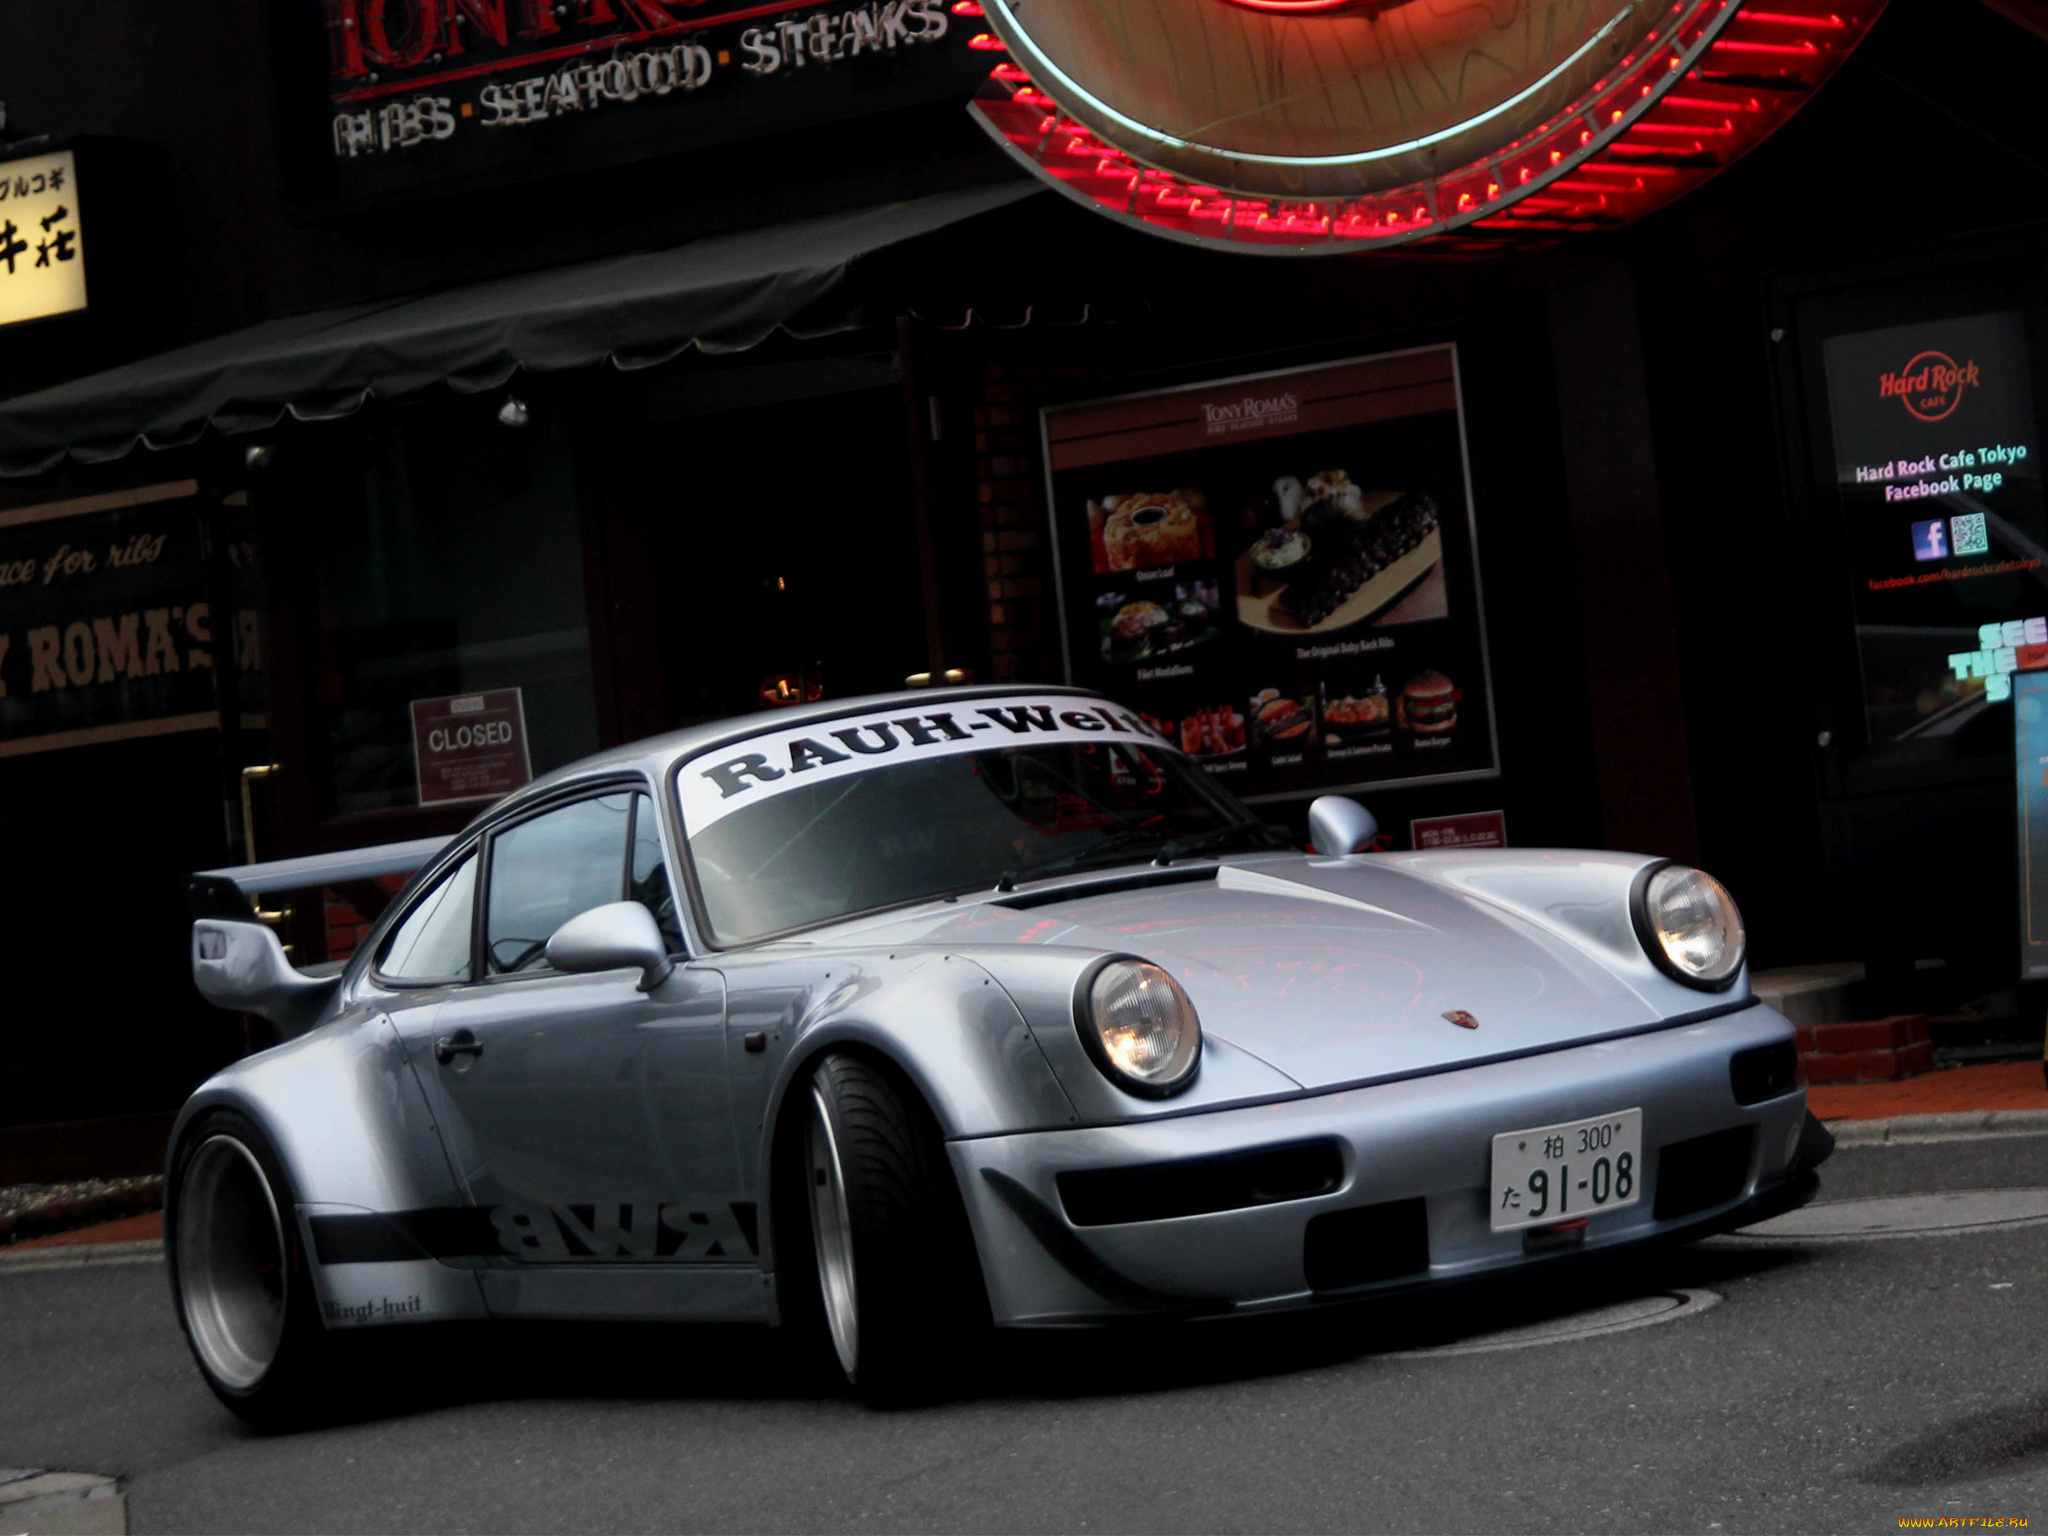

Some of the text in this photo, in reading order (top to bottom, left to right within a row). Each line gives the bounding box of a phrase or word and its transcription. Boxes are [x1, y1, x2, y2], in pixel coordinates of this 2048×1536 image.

[333, 95, 457, 157] RIBS
[480, 43, 712, 127] SEAFOOD
[739, 0, 949, 75] STEAKS
[1879, 359, 1980, 397] Hard Rock
[1856, 444, 2028, 484] Hard Rock Cafe Tokyo
[1885, 471, 2003, 503] Facebook Page
[43, 543, 99, 586] for
[106, 532, 168, 568] ribs
[27, 601, 216, 694] ROMA'S
[1978, 616, 2048, 650] SEE
[1948, 646, 2018, 681] THE
[428, 720, 514, 753] CLOSED
[1543, 1123, 1612, 1159] 柏 300
[1502, 1151, 1634, 1217] た 91-08
